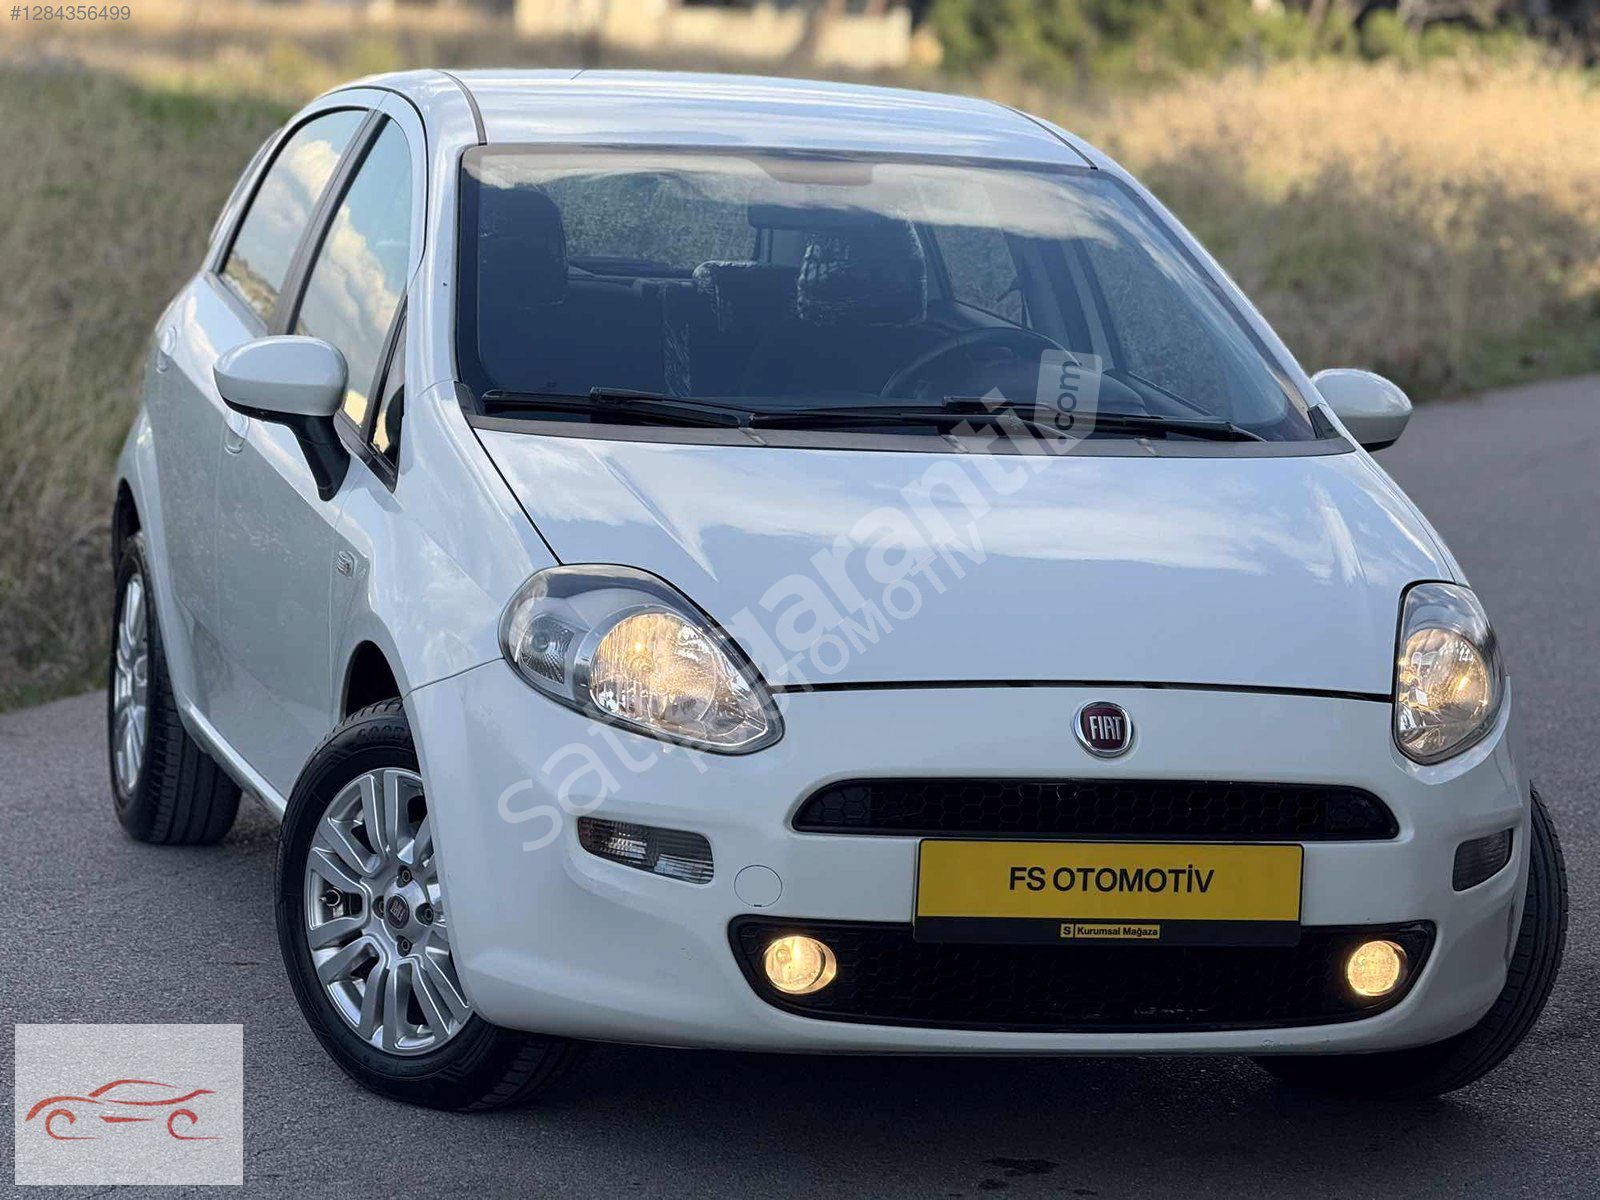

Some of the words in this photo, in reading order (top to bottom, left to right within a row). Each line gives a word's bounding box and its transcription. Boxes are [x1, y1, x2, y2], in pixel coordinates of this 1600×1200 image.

[1089, 715, 1122, 740] FIAT
[1009, 866, 1046, 891] FS
[1052, 864, 1215, 893] OTOMOTİV
[1063, 926, 1071, 935] S
[1077, 926, 1121, 936] Kurumsal
[1122, 927, 1158, 937] Mağaza
